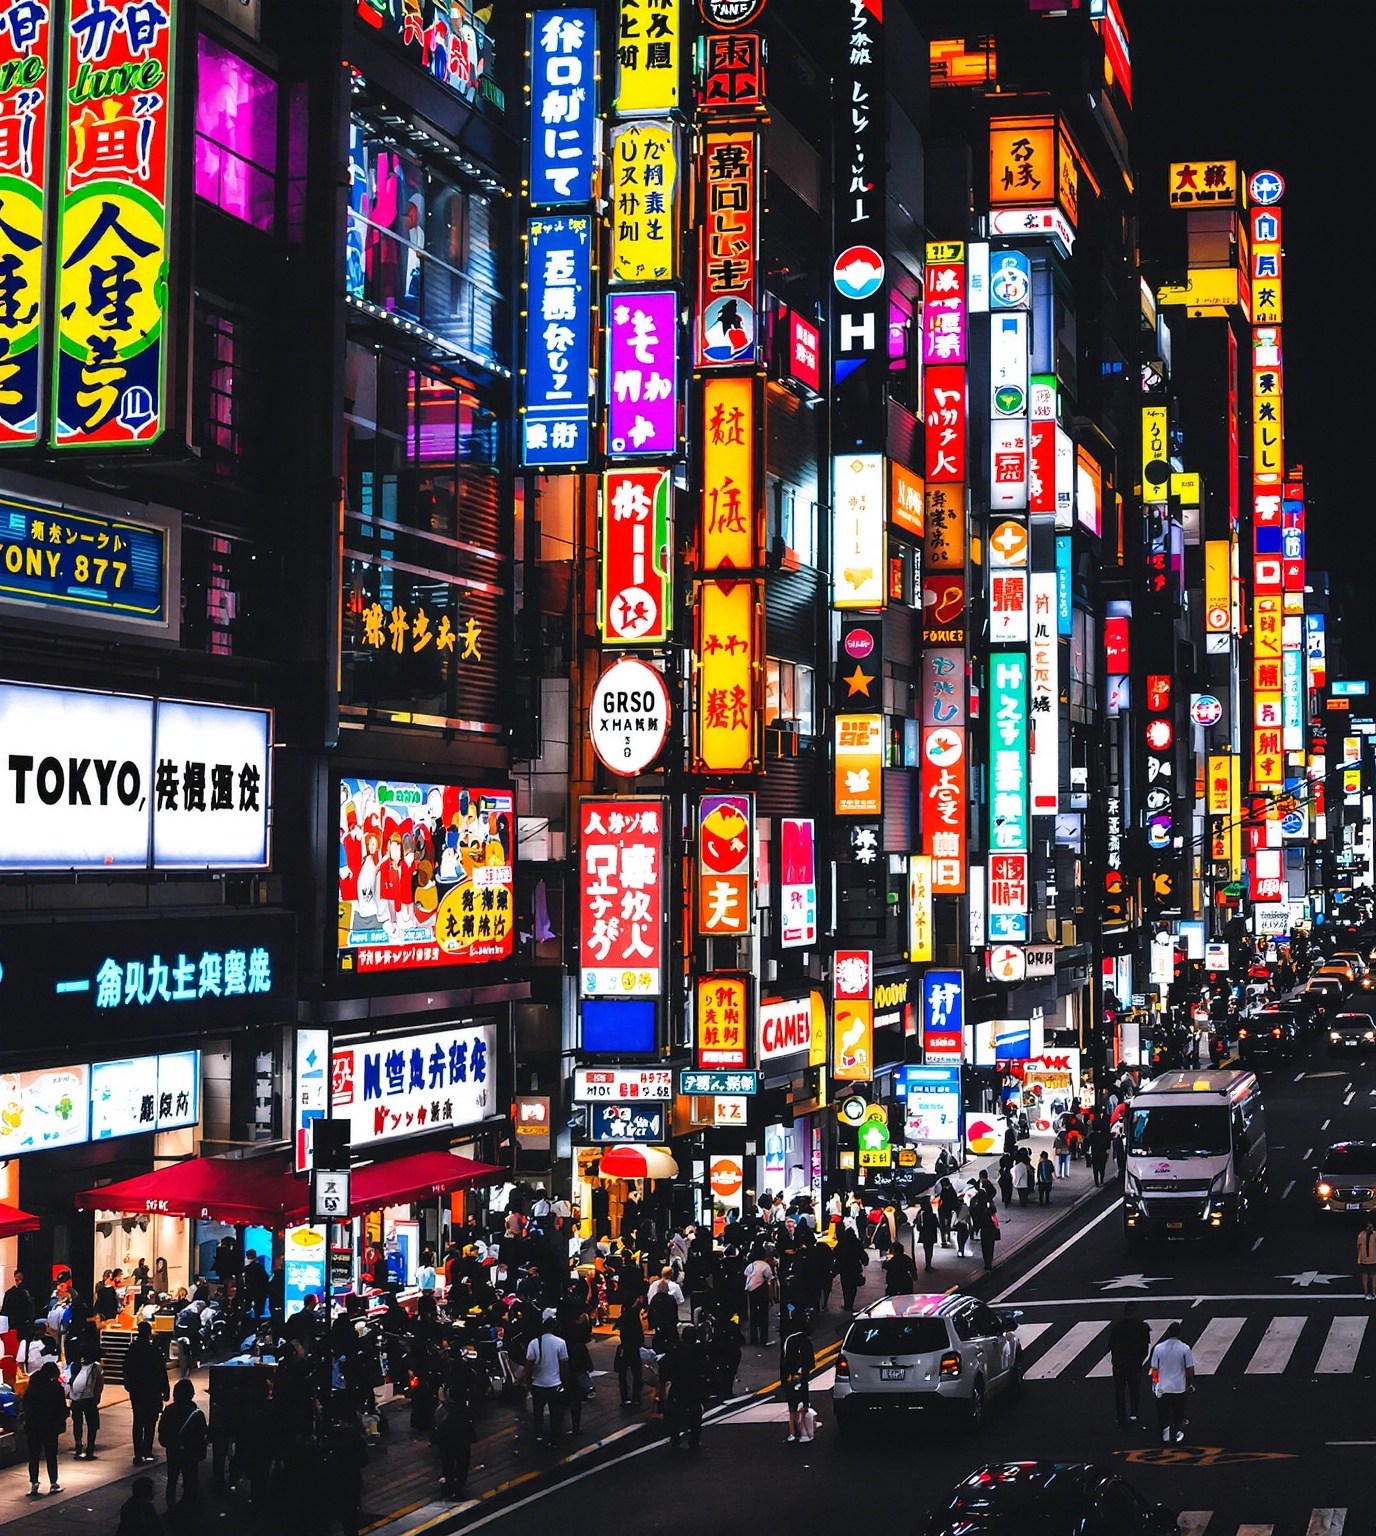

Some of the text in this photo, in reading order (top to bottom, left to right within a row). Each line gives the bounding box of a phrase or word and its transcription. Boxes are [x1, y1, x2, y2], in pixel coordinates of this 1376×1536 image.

[840, 313, 874, 352] H
[0, 542, 128, 589] ONY 877
[603, 691, 655, 713] GRSO
